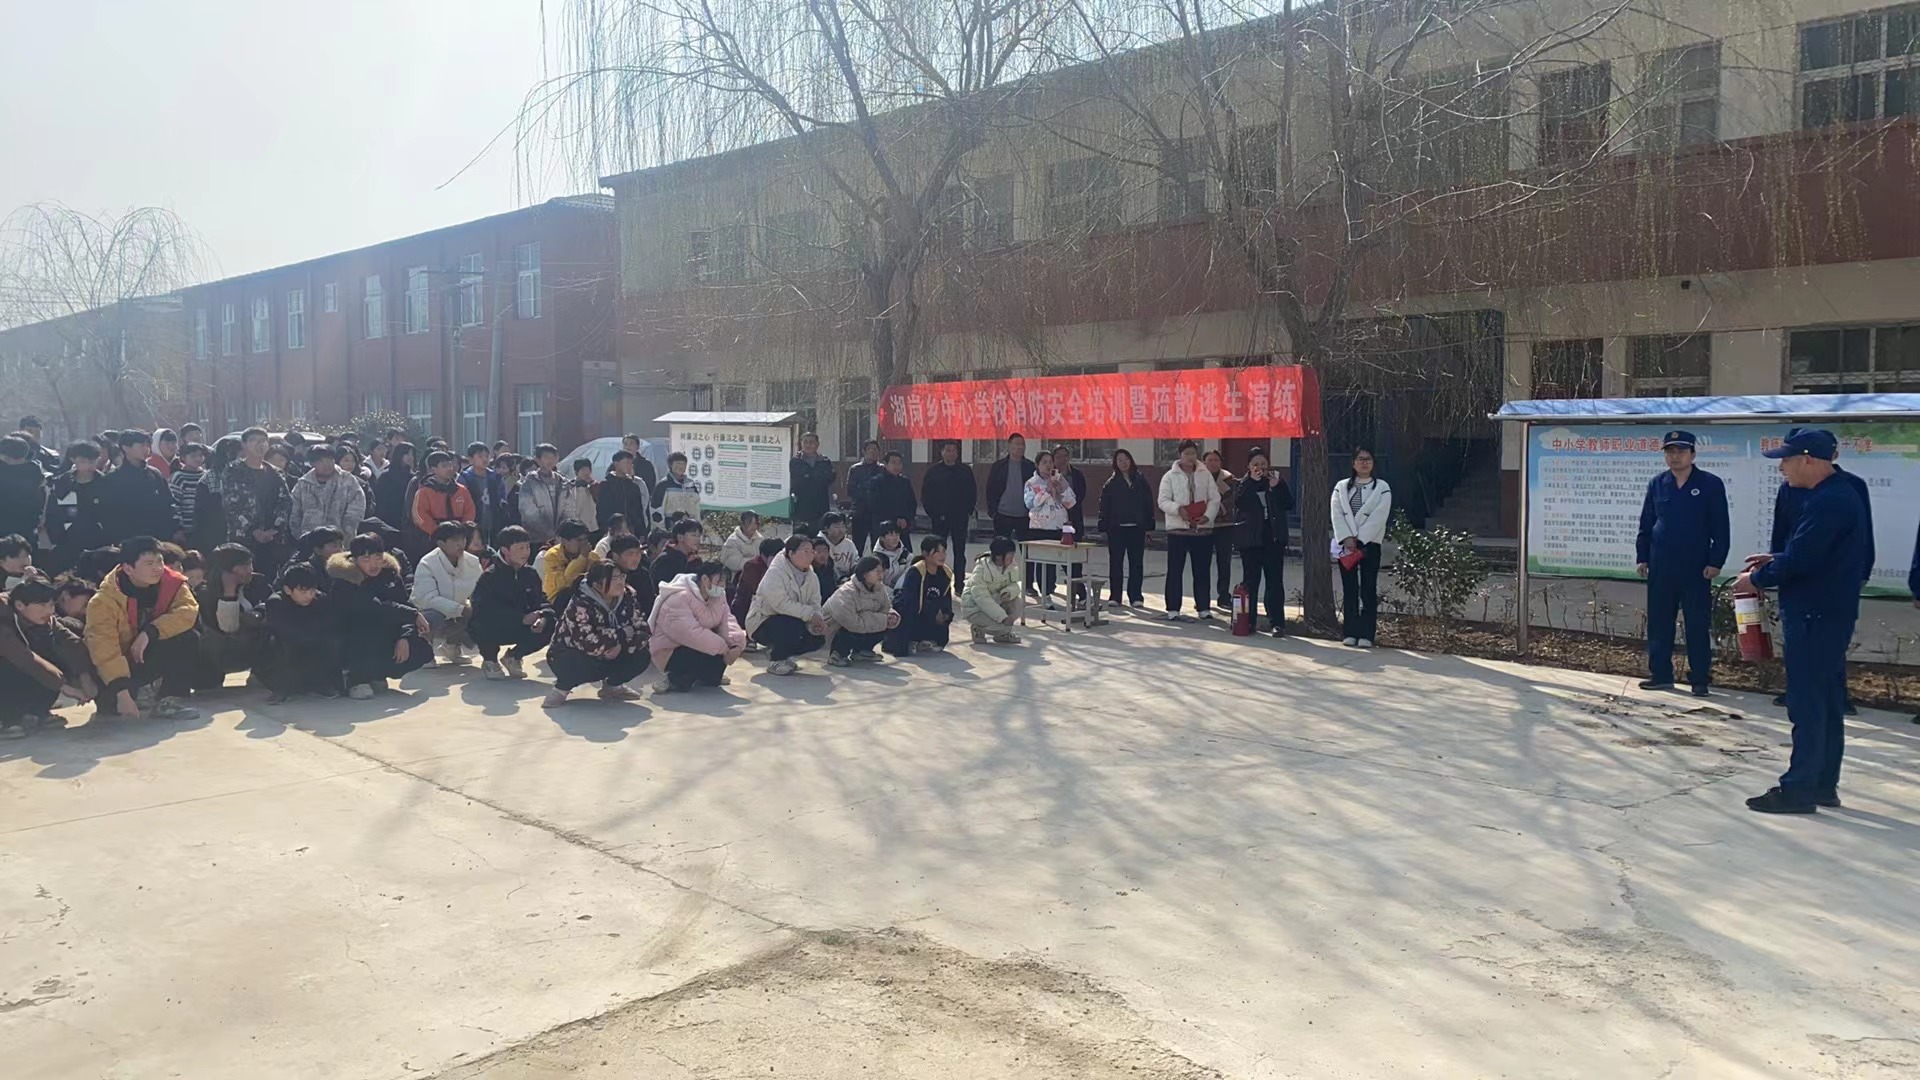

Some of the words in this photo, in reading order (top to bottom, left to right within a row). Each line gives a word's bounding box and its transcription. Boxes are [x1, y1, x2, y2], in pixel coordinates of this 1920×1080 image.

[890, 379, 1297, 429] 湖岗乡中心学校消防安全培训暨疏散逃生演练
[1552, 437, 1662, 452] 中小学教师职业道德
